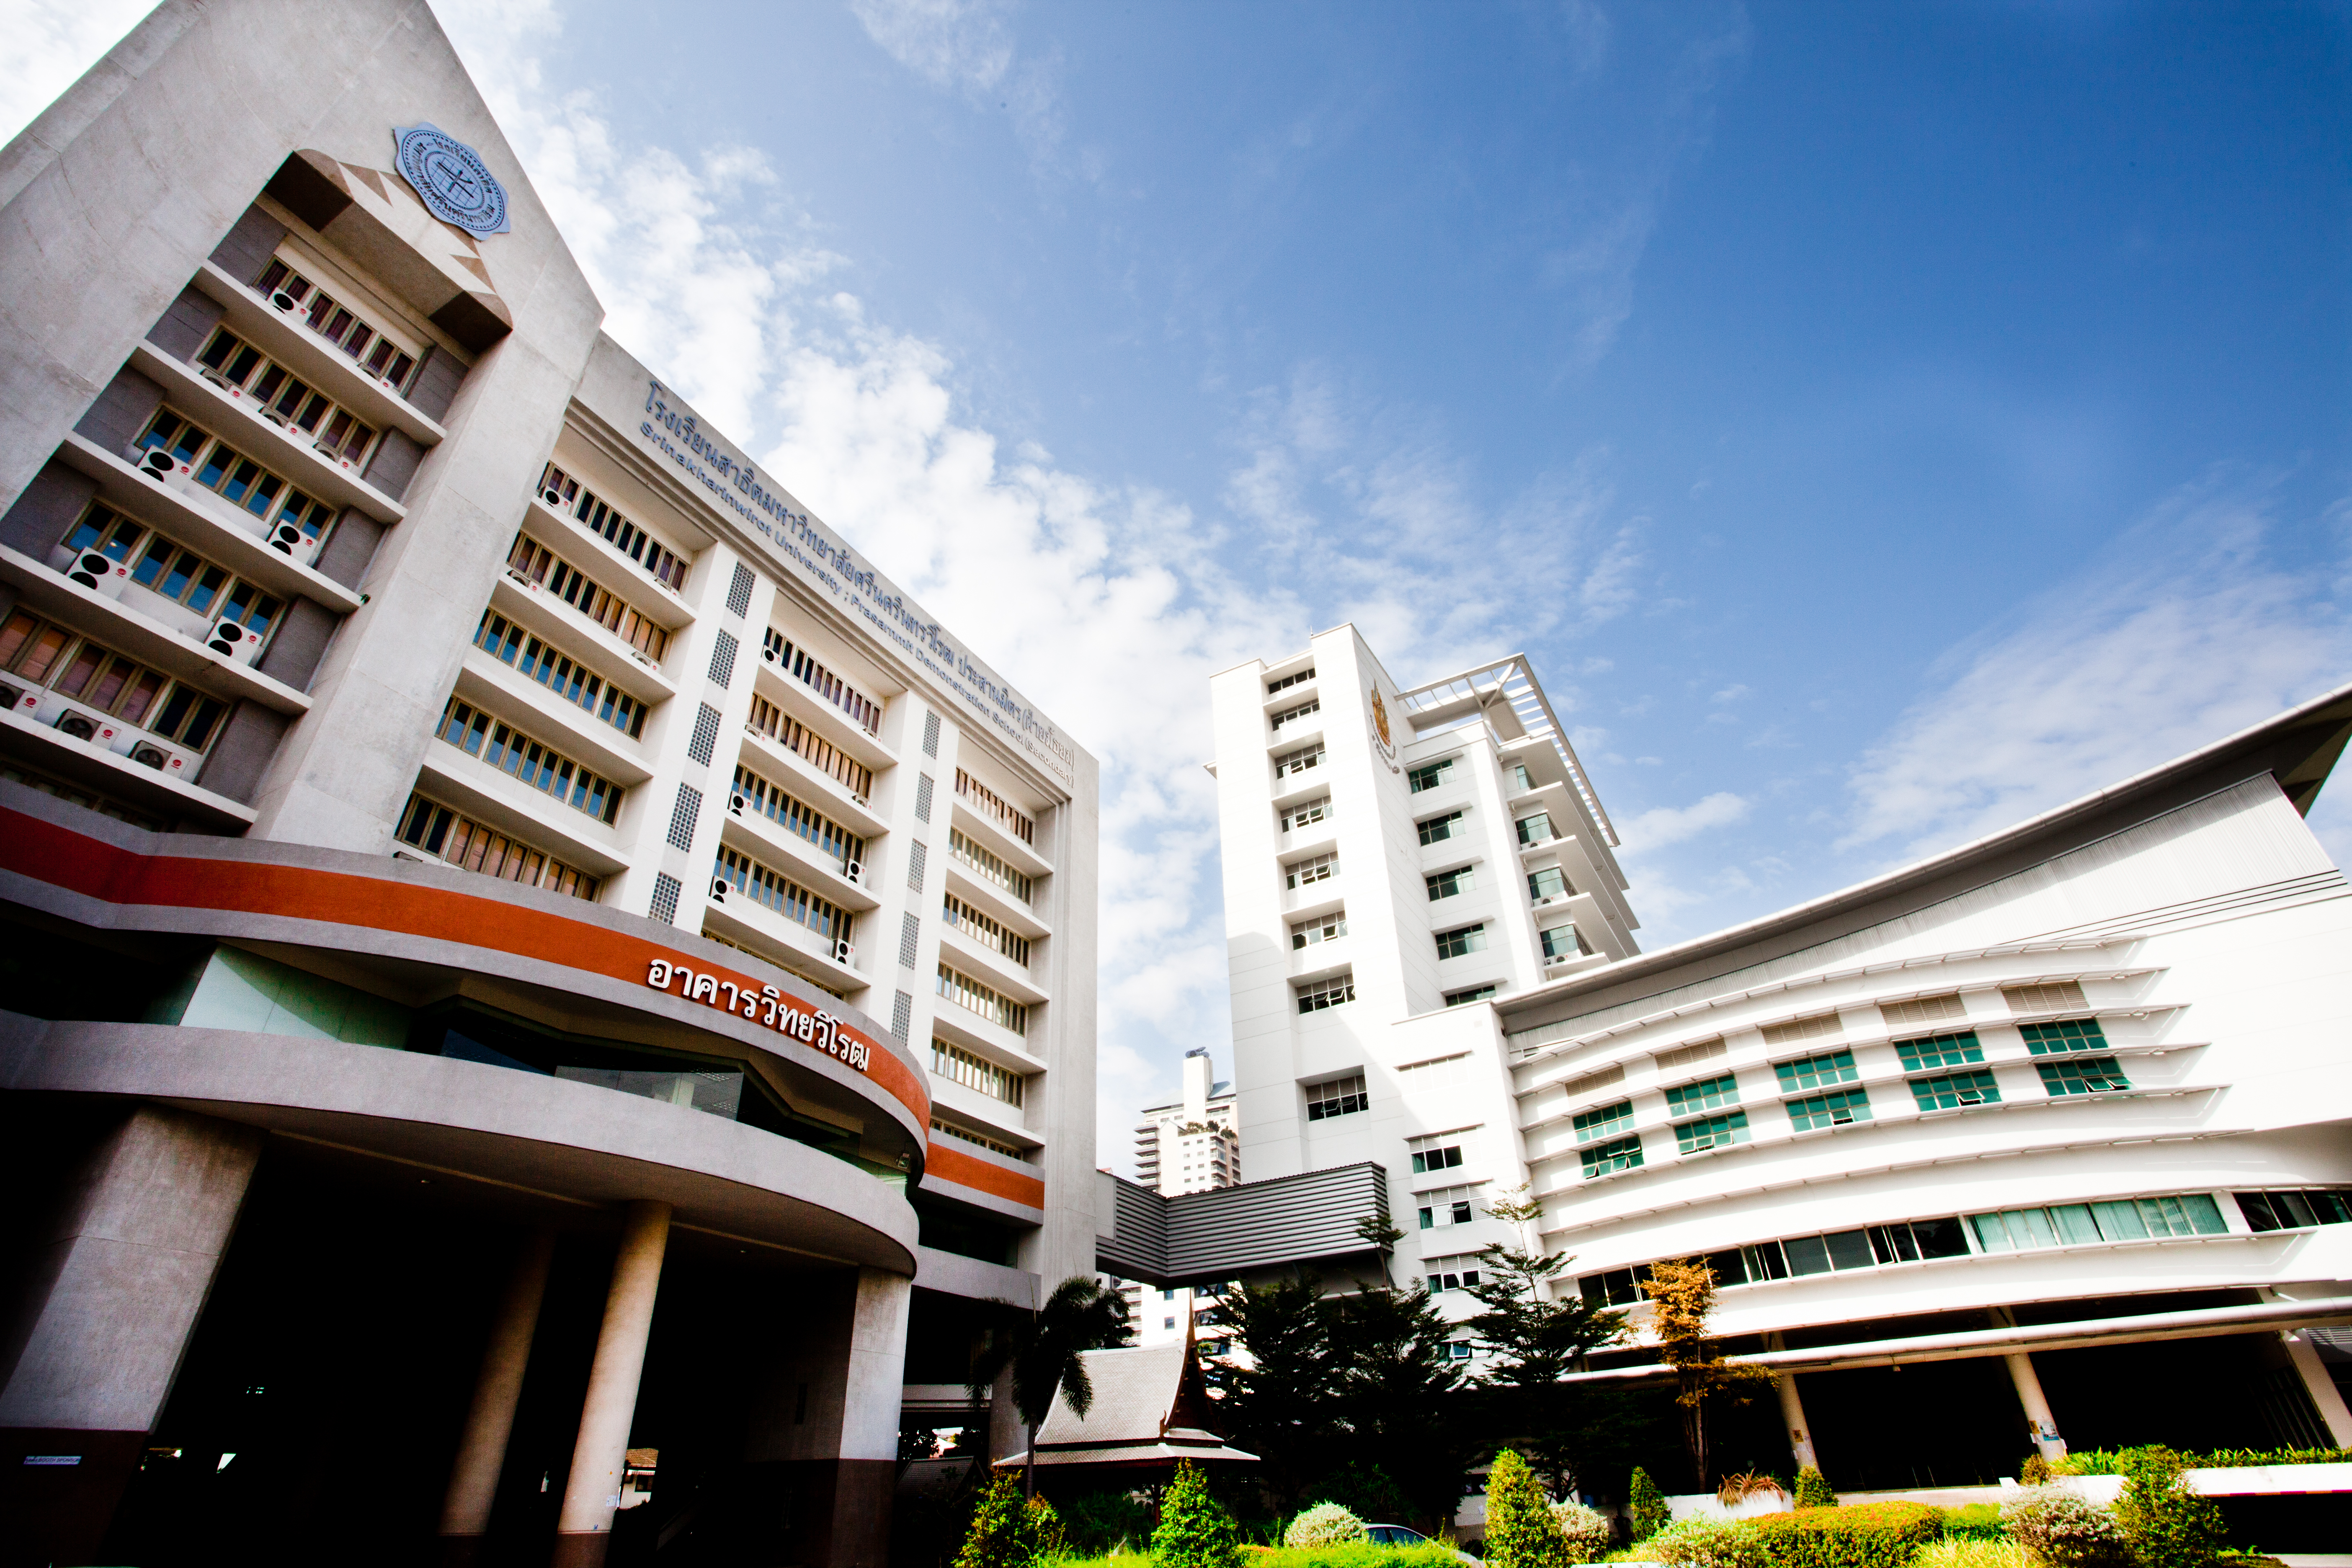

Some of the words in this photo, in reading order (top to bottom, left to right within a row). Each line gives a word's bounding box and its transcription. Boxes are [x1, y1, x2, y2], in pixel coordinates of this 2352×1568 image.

[640, 421, 772, 536] Srinakharinwirot
[775, 531, 842, 595] University
[851, 594, 913, 654] Prasarnmit
[916, 647, 990, 717] Demonstration
[992, 711, 1024, 745] School
[1026, 738, 1075, 788] (Secondary)
[646, 380, 955, 667] โรงเรียนสาธิตมหาวิทยาลัยศรีนครินทรวิโรฒ
[958, 655, 1021, 723] ประสานมิตร
[648, 959, 870, 1071] อาคารวิทยวิโรฒ
